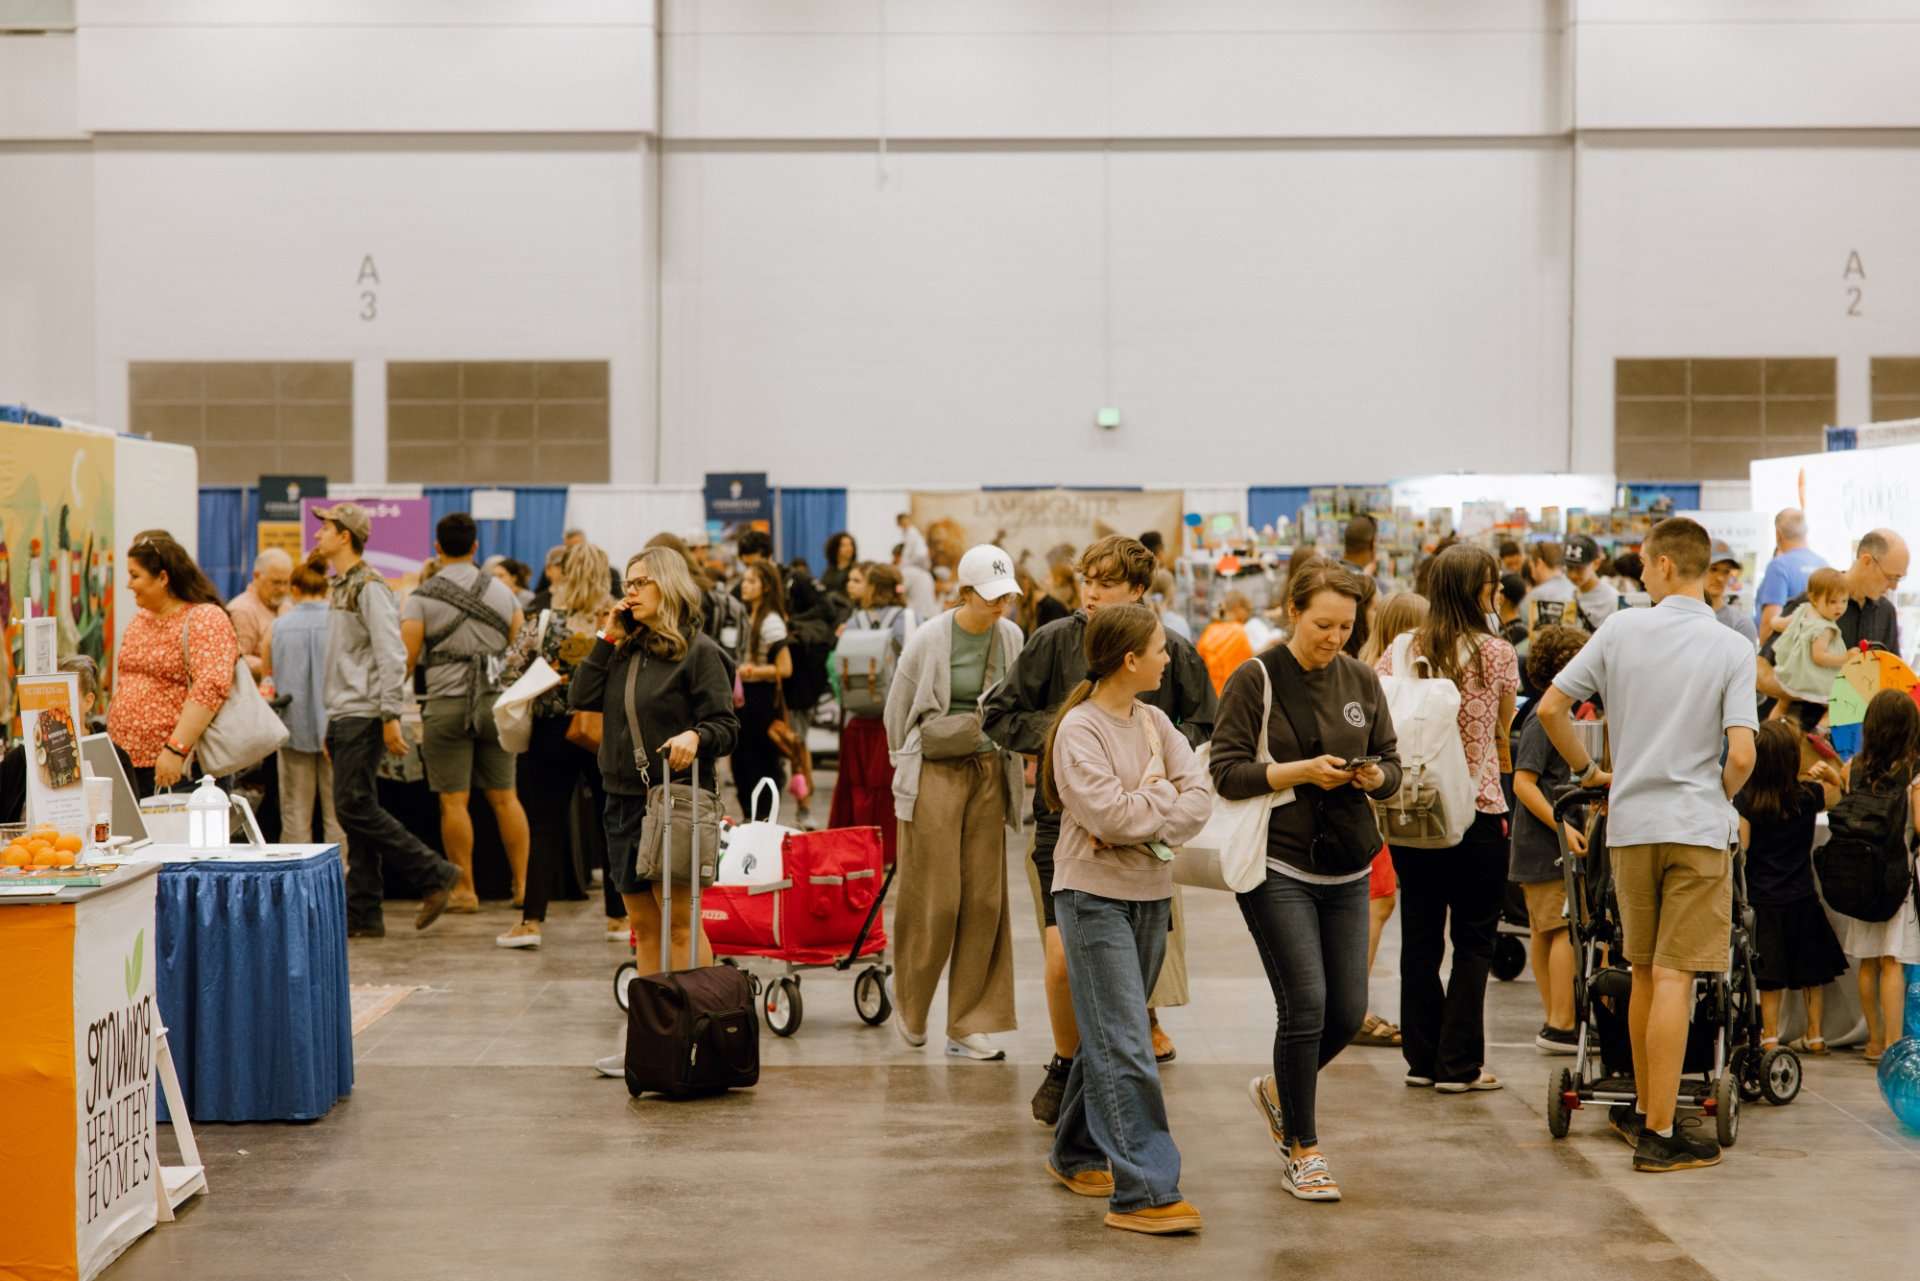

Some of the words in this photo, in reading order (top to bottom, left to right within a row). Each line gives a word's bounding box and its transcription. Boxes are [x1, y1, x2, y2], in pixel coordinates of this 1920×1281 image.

[357, 253, 381, 285] A
[1842, 249, 1866, 280] A
[360, 290, 377, 321] 3
[1846, 286, 1862, 317] 2
[86, 994, 152, 1115] growing
[86, 1083, 151, 1170] HEALTHY
[87, 1133, 152, 1224] HOMES
